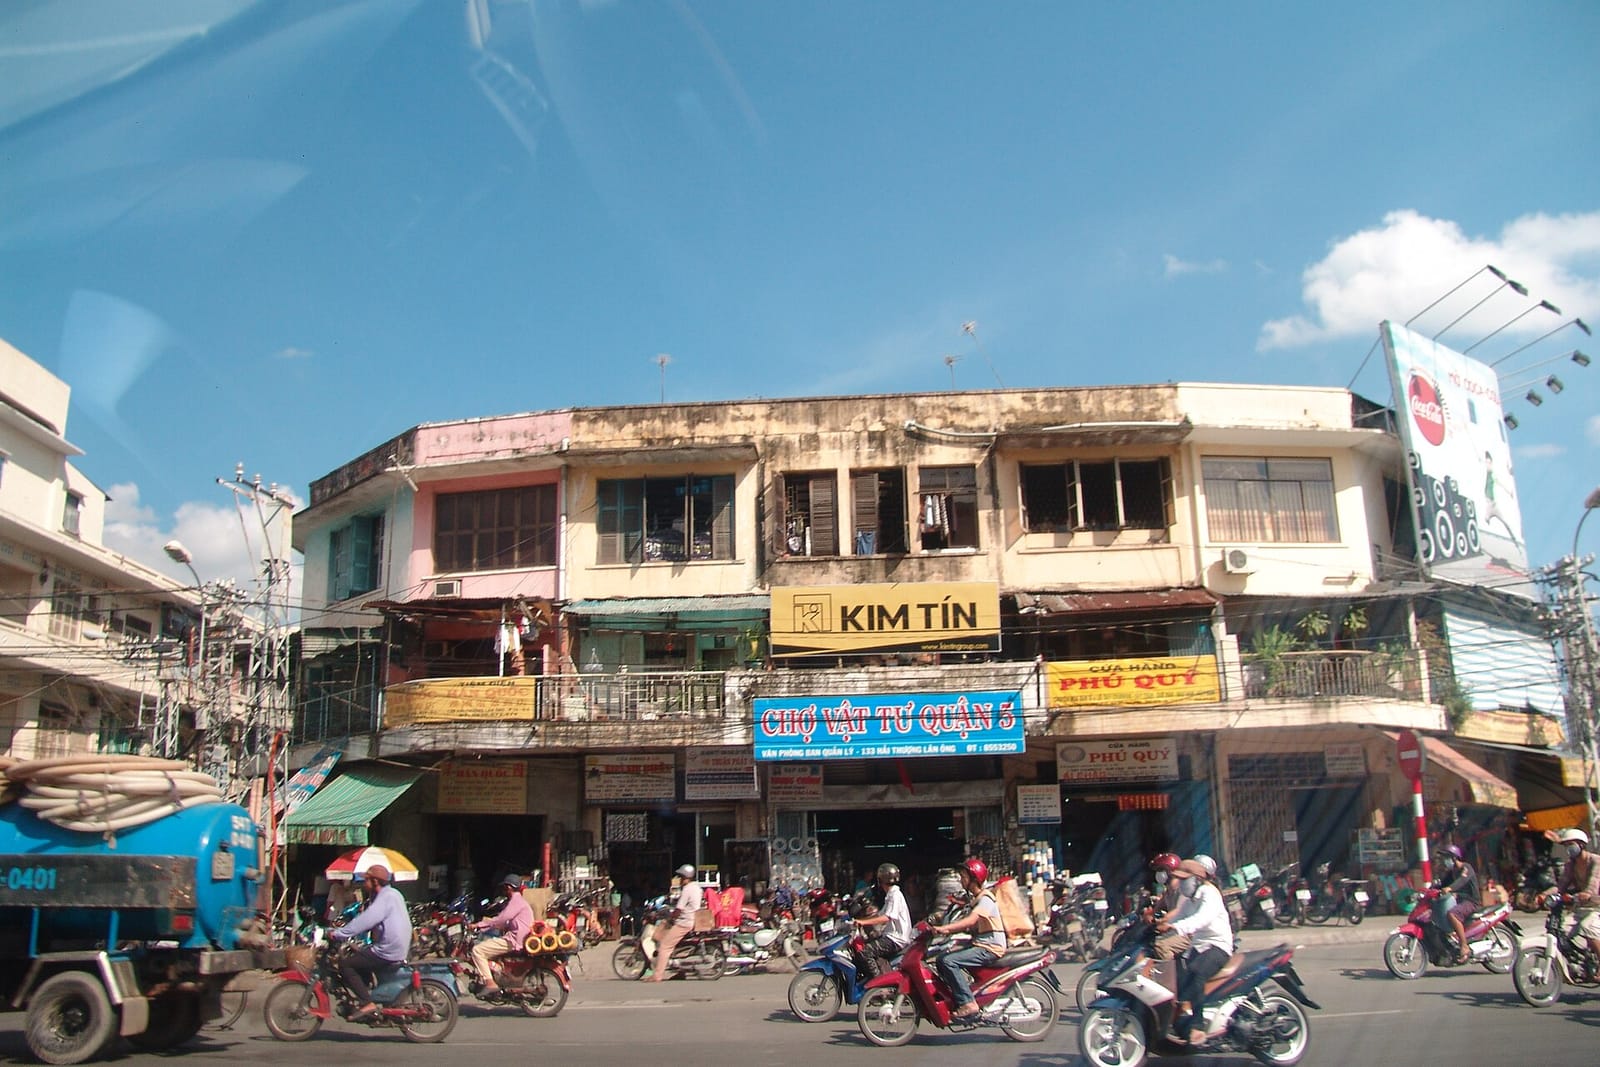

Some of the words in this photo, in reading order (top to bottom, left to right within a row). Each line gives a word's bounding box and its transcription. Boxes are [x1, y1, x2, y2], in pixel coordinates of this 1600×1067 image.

[840, 604, 909, 631] KIM
[917, 595, 977, 629] TÍN
[1059, 673, 1124, 691] PHÚ
[761, 704, 817, 743] CHỢ
[821, 699, 871, 743] VẬT
[876, 701, 915, 734] TƯ
[919, 696, 993, 739] QUẬN
[999, 702, 1016, 731] 5
[1089, 749, 1127, 764] PHÚ
[1133, 747, 1170, 763] QUÝ
